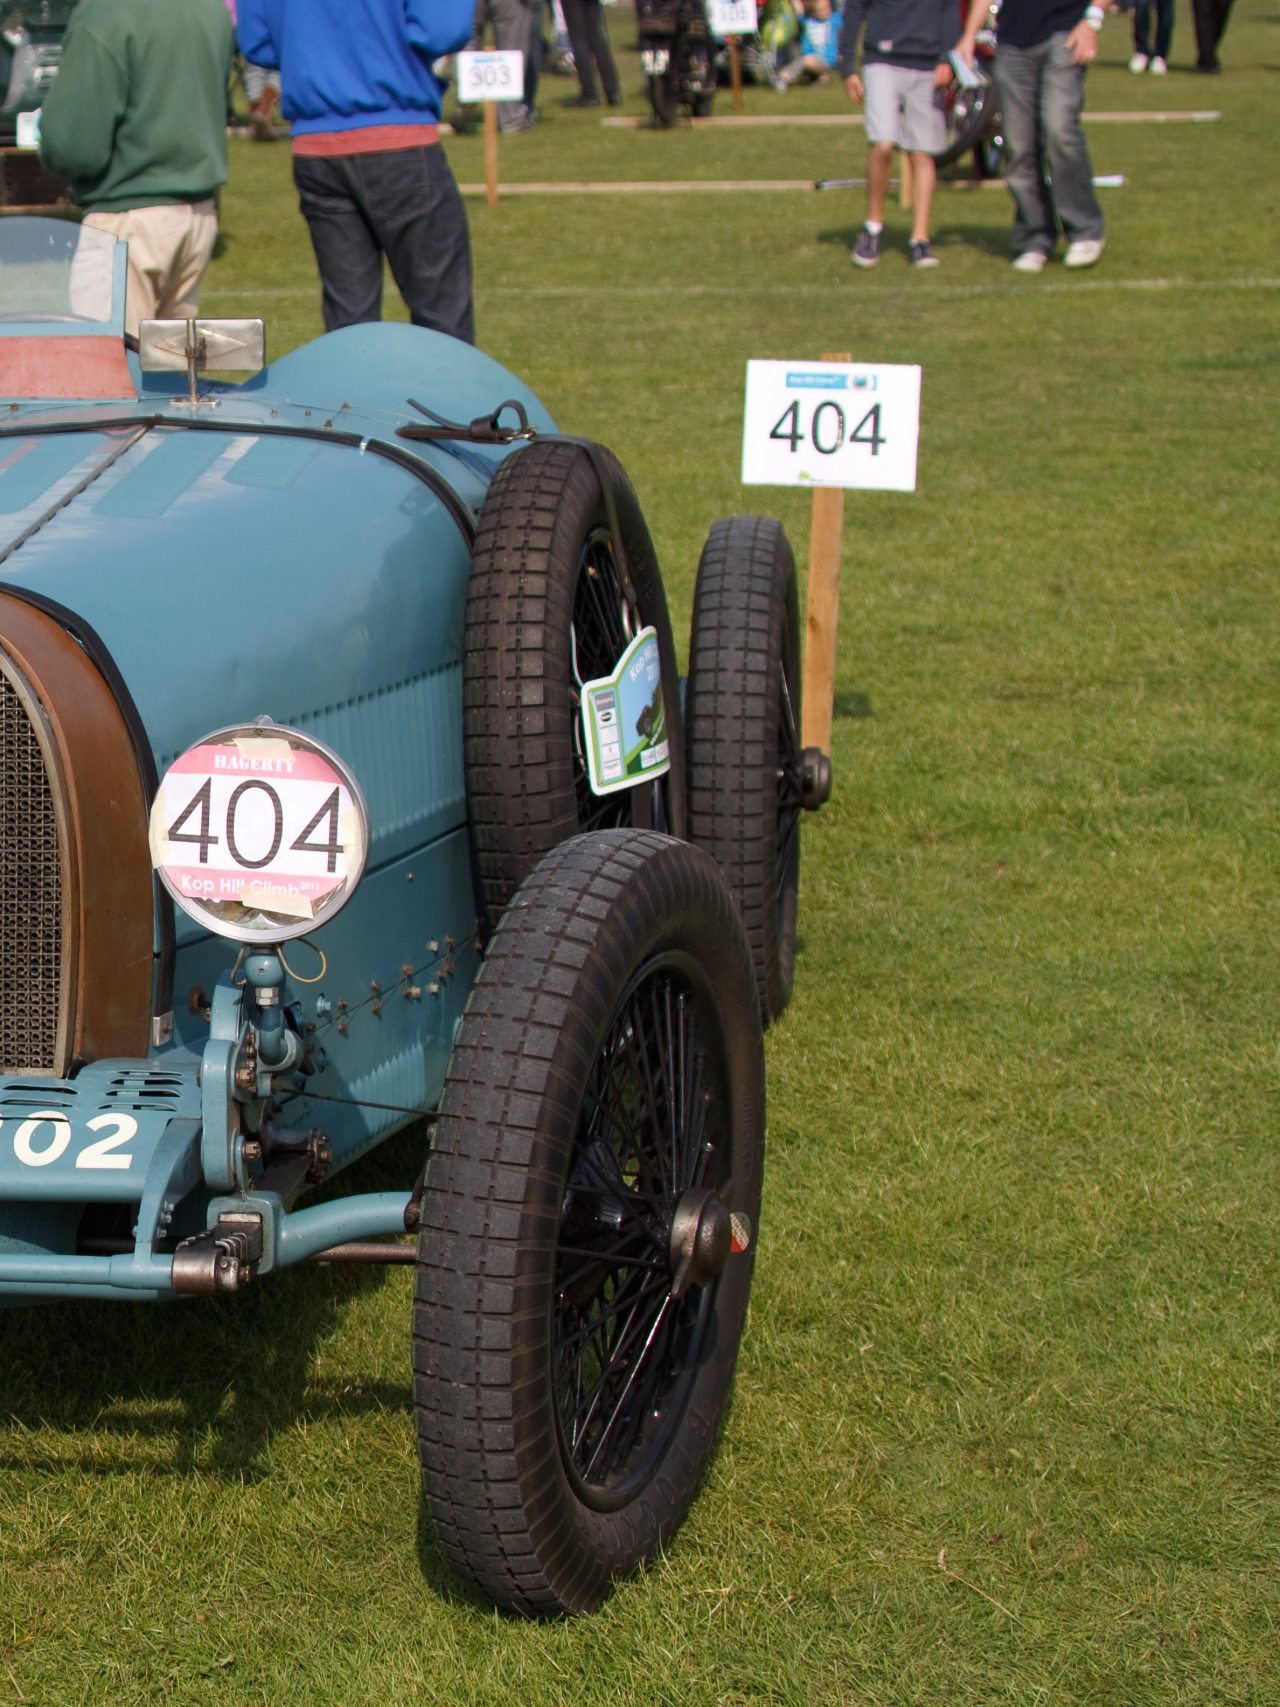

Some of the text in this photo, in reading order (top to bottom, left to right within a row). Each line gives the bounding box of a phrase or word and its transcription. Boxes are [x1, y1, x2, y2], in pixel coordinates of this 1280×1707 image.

[470, 64, 511, 87] 303
[770, 399, 886, 456] 404
[214, 754, 297, 773] HAGERTY
[168, 776, 344, 873] 404
[181, 874, 214, 894] Kop
[220, 879, 244, 894] Hill
[250, 879, 300, 896] Climb
